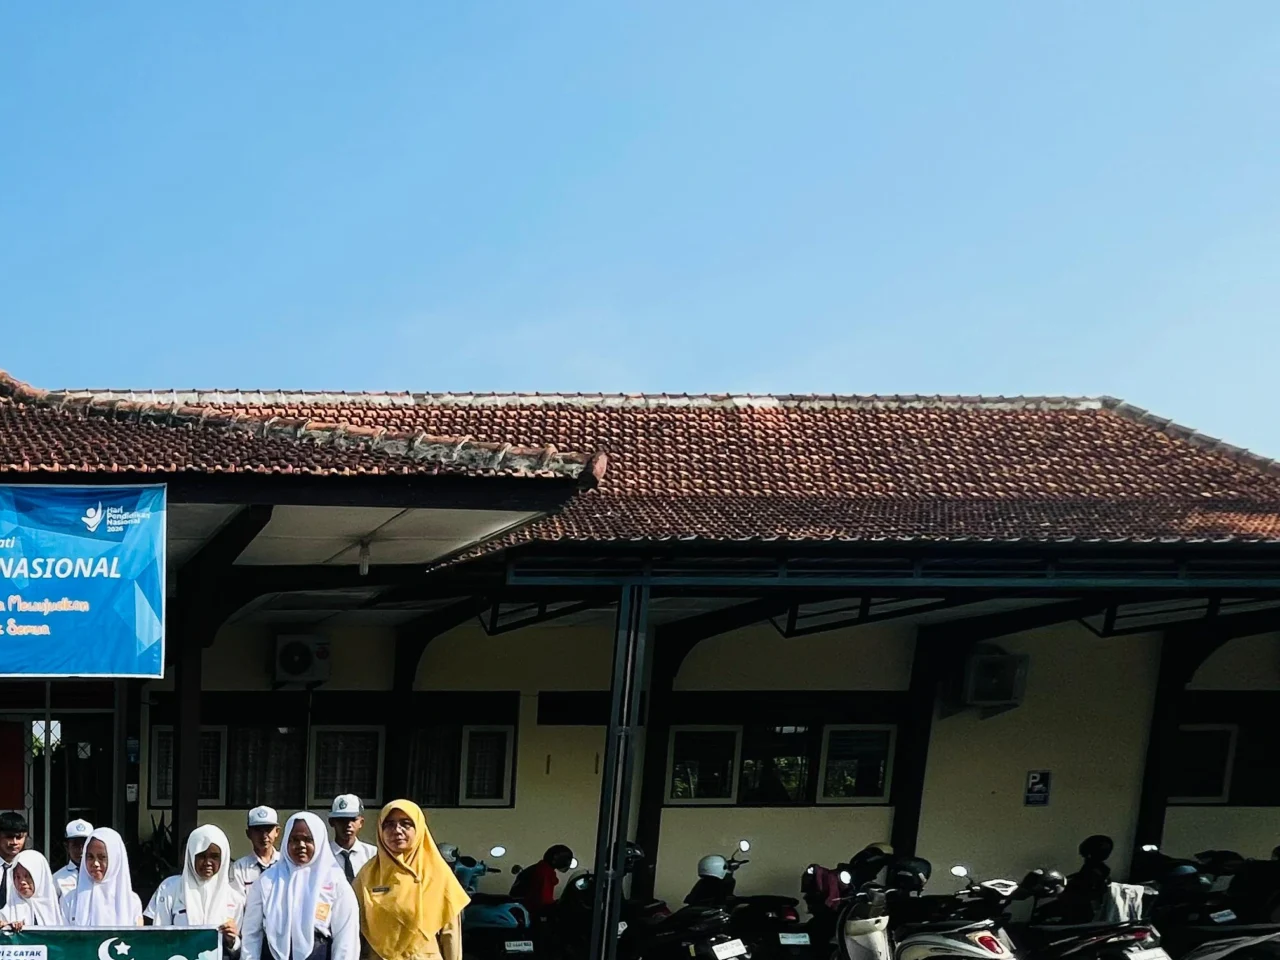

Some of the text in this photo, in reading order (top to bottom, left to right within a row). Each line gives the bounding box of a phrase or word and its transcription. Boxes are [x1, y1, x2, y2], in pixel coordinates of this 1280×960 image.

[107, 518, 140, 526] Nasional
[6, 618, 51, 636] Semua
[1029, 774, 1040, 788] P
